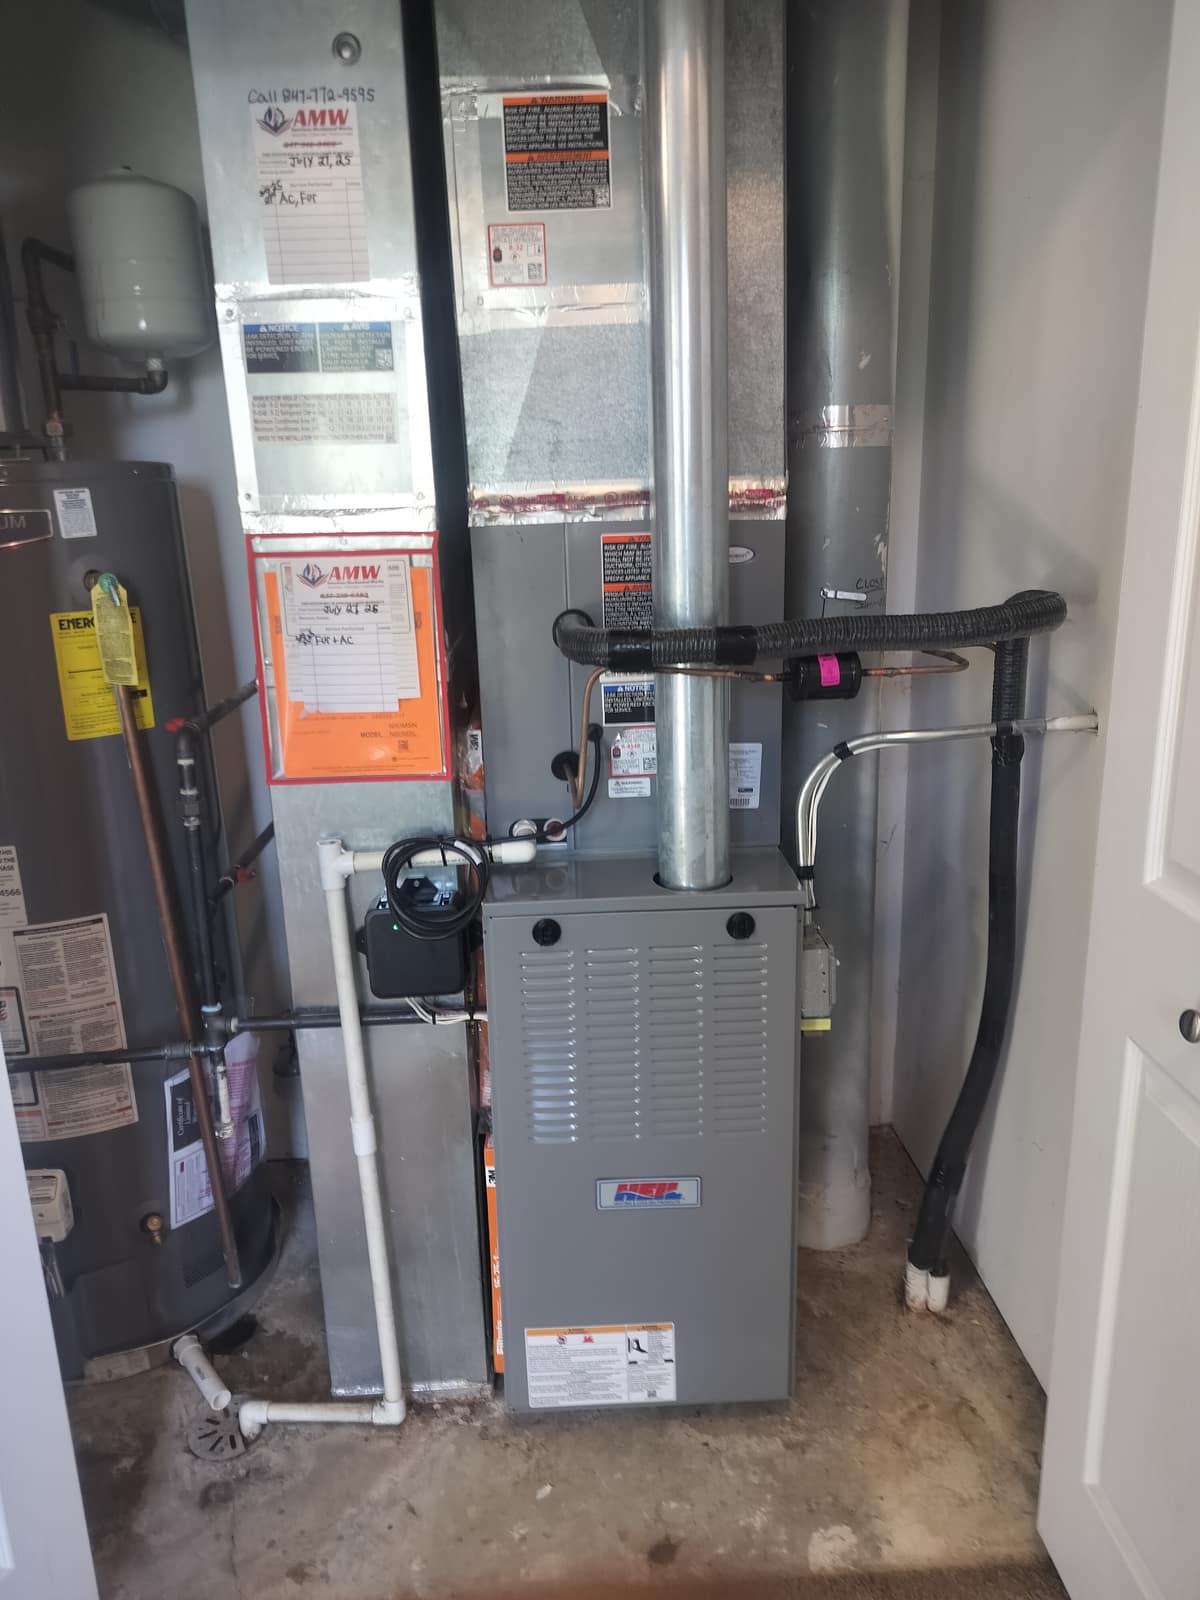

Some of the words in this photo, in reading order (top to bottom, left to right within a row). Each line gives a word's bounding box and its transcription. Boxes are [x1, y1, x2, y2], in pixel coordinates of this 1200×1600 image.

[248, 88, 277, 104] Call
[293, 108, 349, 128] AMW
[328, 565, 381, 580] AMW
[488, 1169, 496, 1185] 3M
